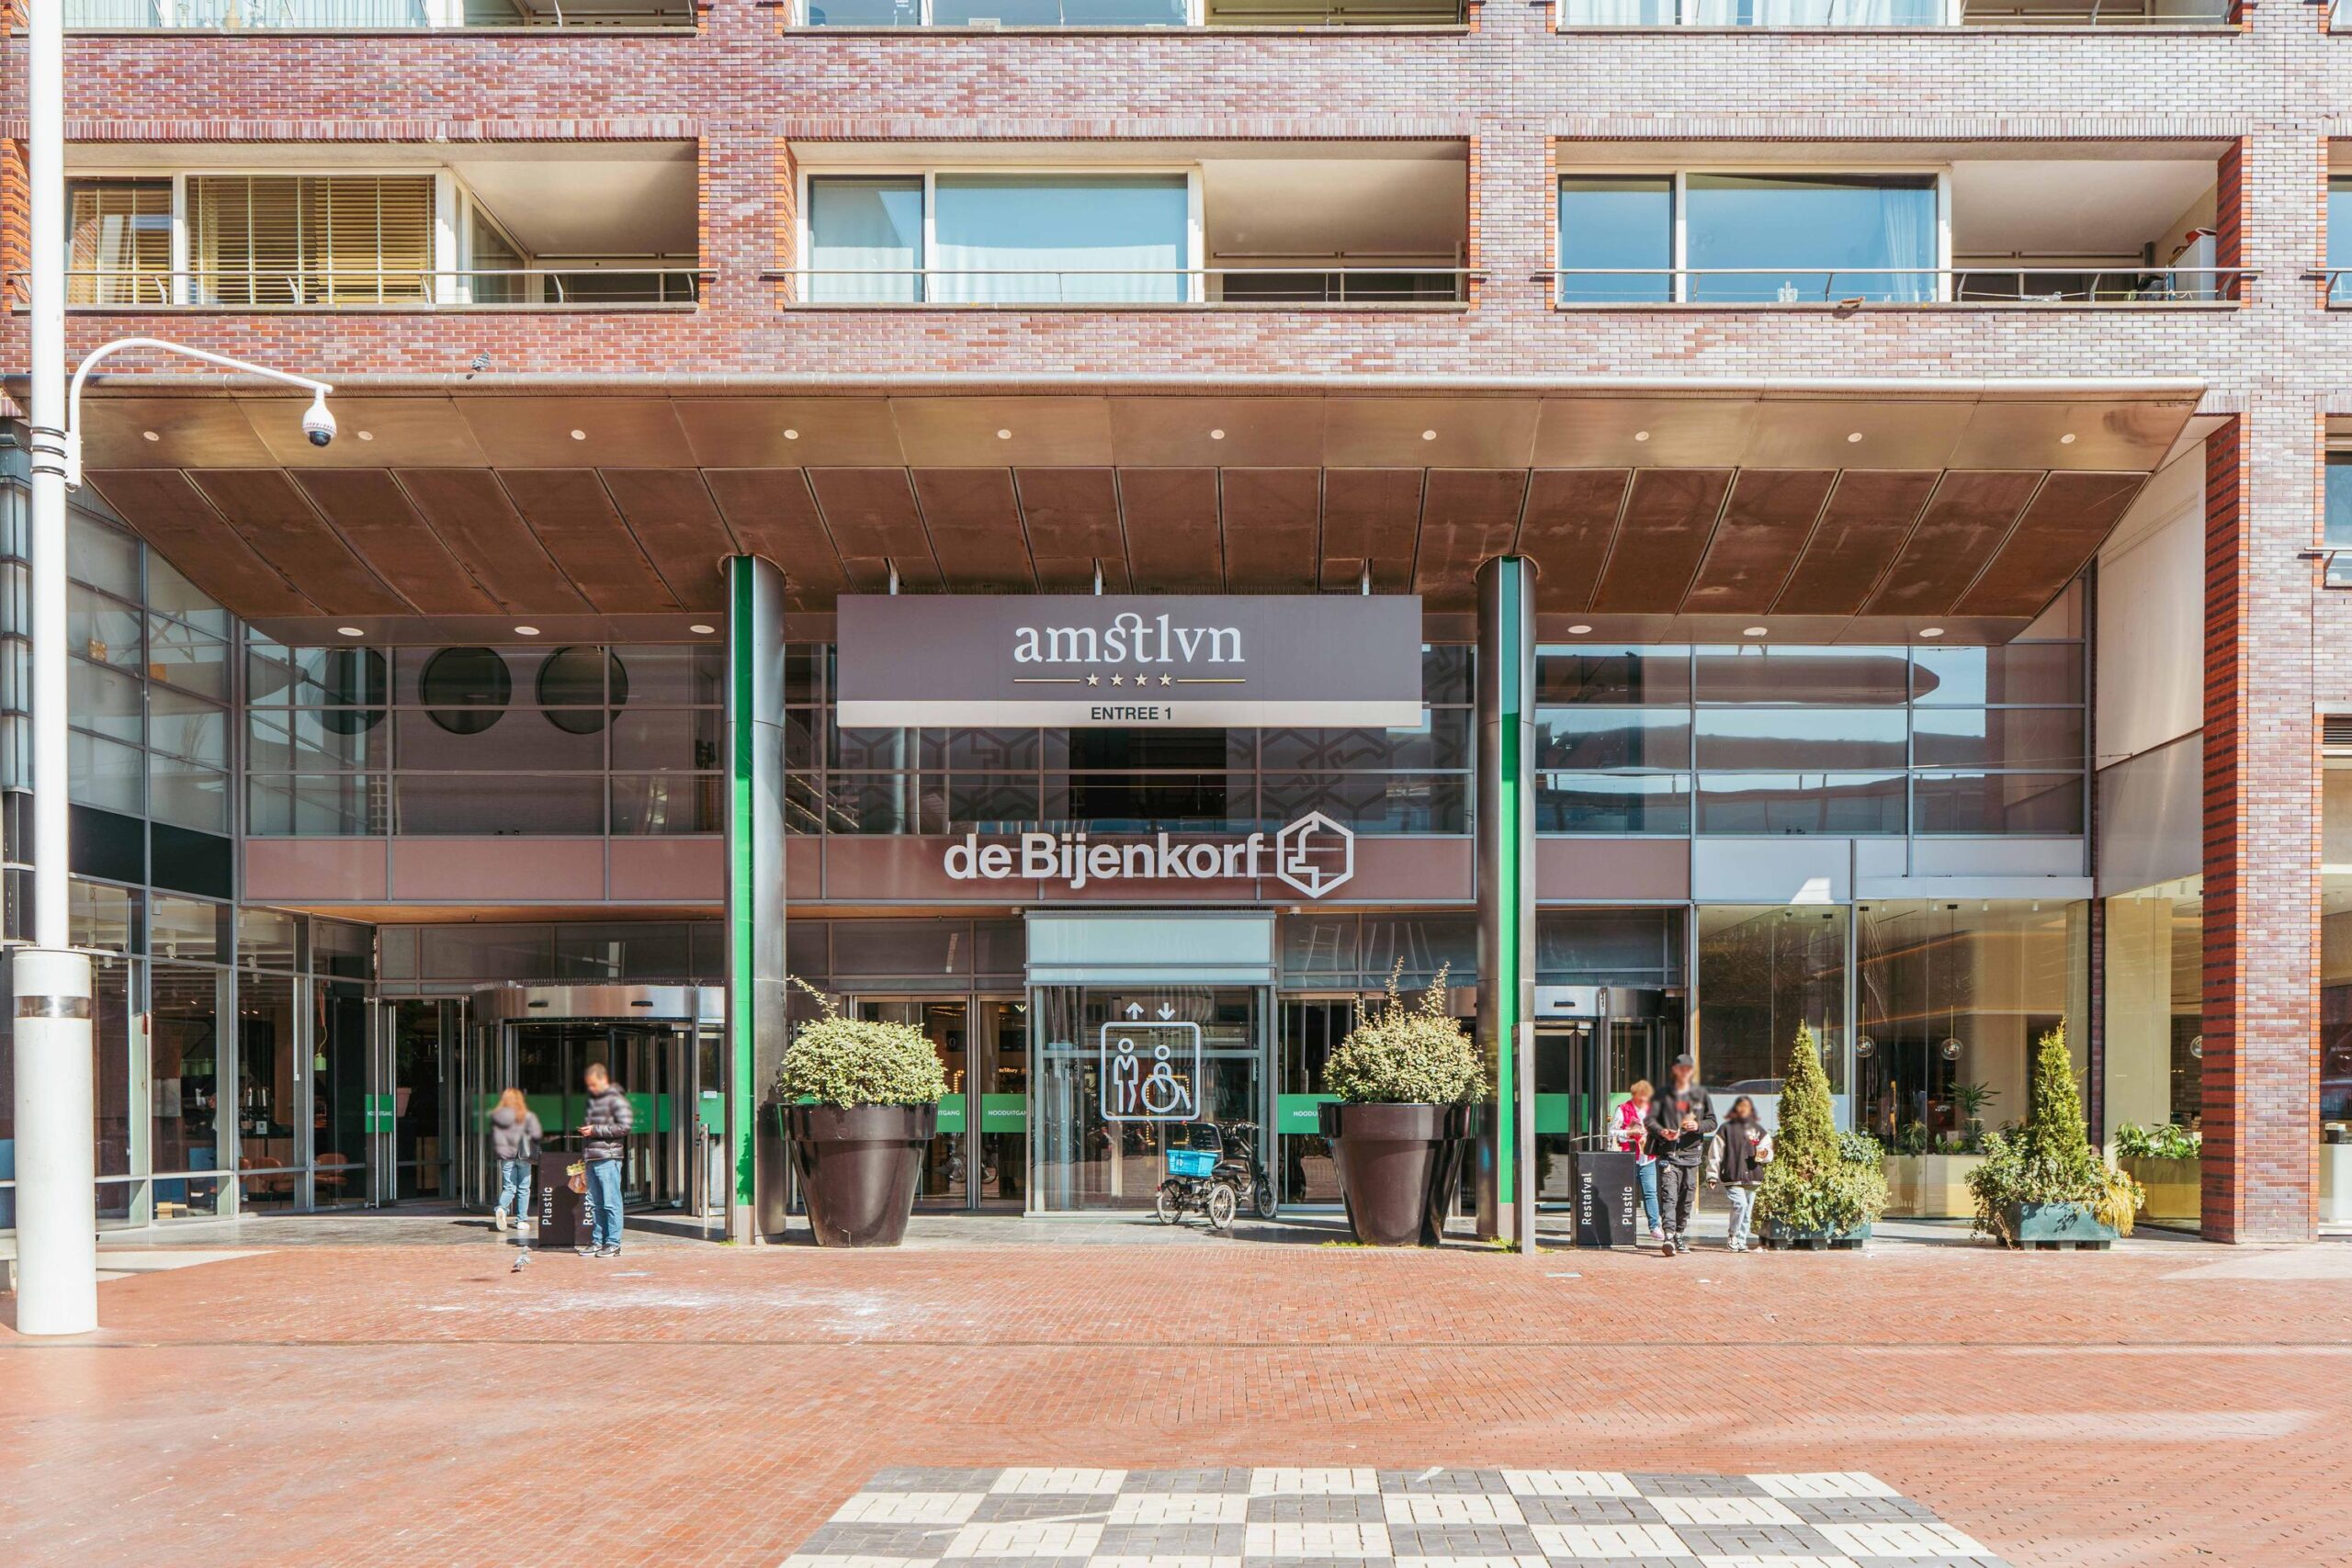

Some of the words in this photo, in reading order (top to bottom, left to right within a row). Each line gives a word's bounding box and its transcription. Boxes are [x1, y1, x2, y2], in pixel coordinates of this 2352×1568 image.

[1013, 612, 1246, 663] amstlvn
[1091, 706, 1159, 720] ENTREE
[1164, 706, 1171, 720] 1
[944, 833, 1012, 880] de
[1022, 832, 1263, 889] Bijenkorf
[542, 1187, 553, 1225] Plastic
[1581, 1172, 1592, 1225] Restafval
[1622, 1186, 1633, 1225] Plastic
